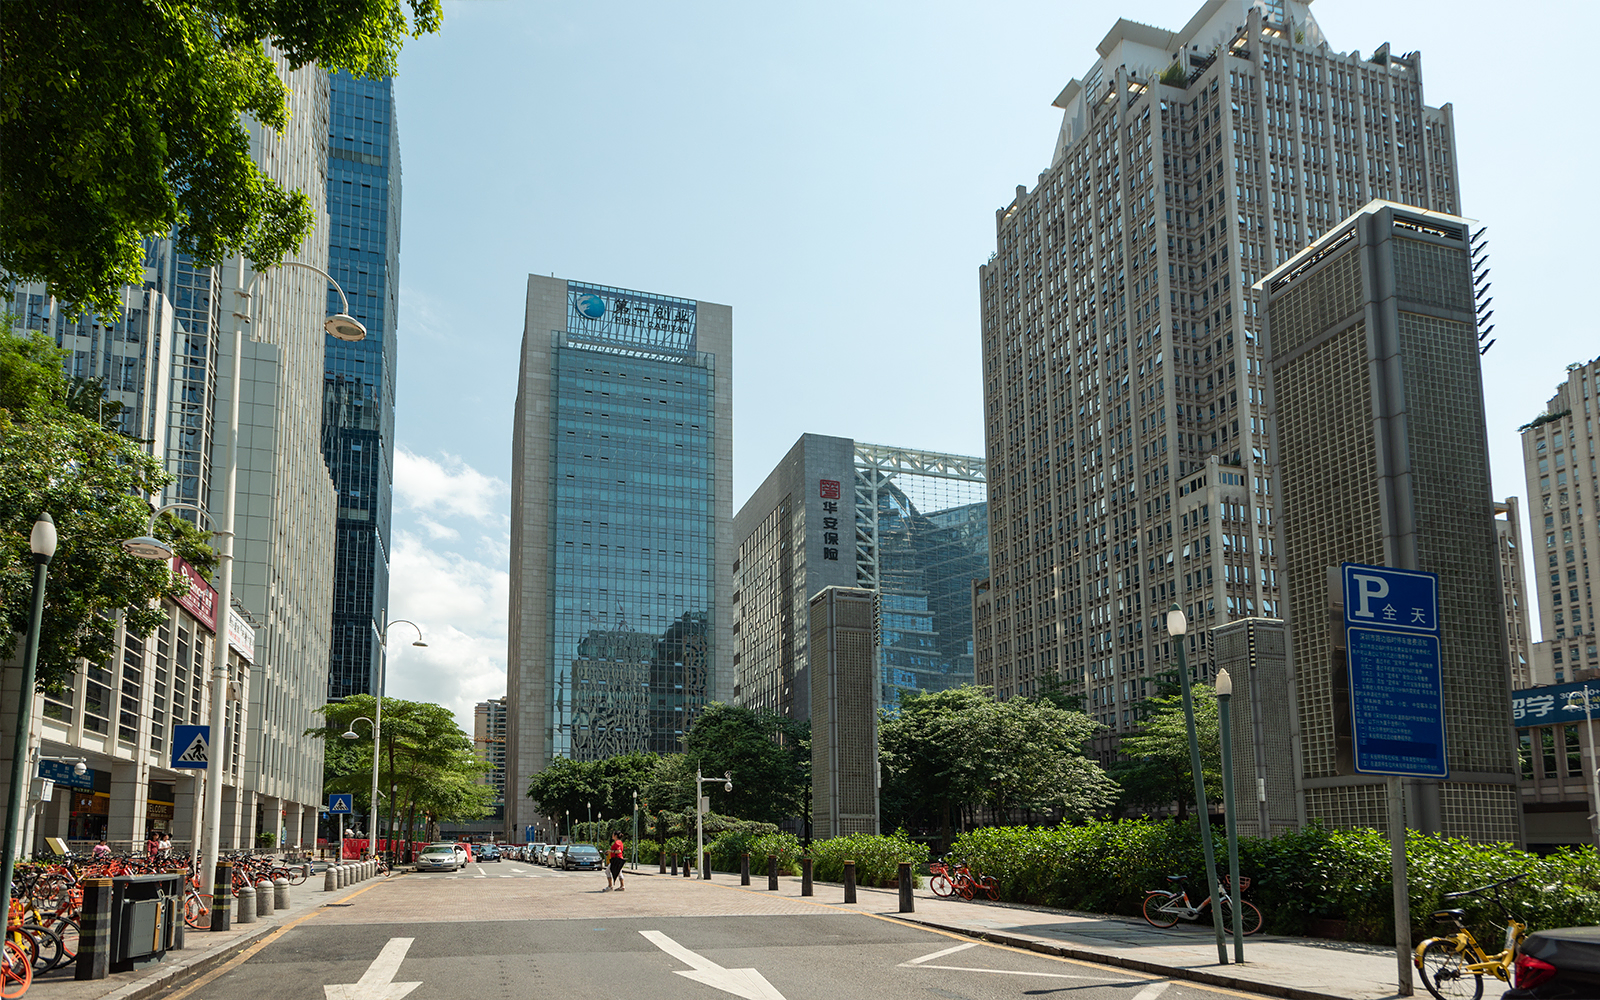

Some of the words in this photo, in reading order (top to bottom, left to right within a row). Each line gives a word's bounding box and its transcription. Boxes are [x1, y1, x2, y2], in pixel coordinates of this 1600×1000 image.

[613, 299, 689, 323] 第一创业
[615, 317, 644, 327] FIRST
[648, 322, 688, 333] CAPITAL
[823, 501, 838, 560] 华安保险
[1353, 574, 1389, 617] P
